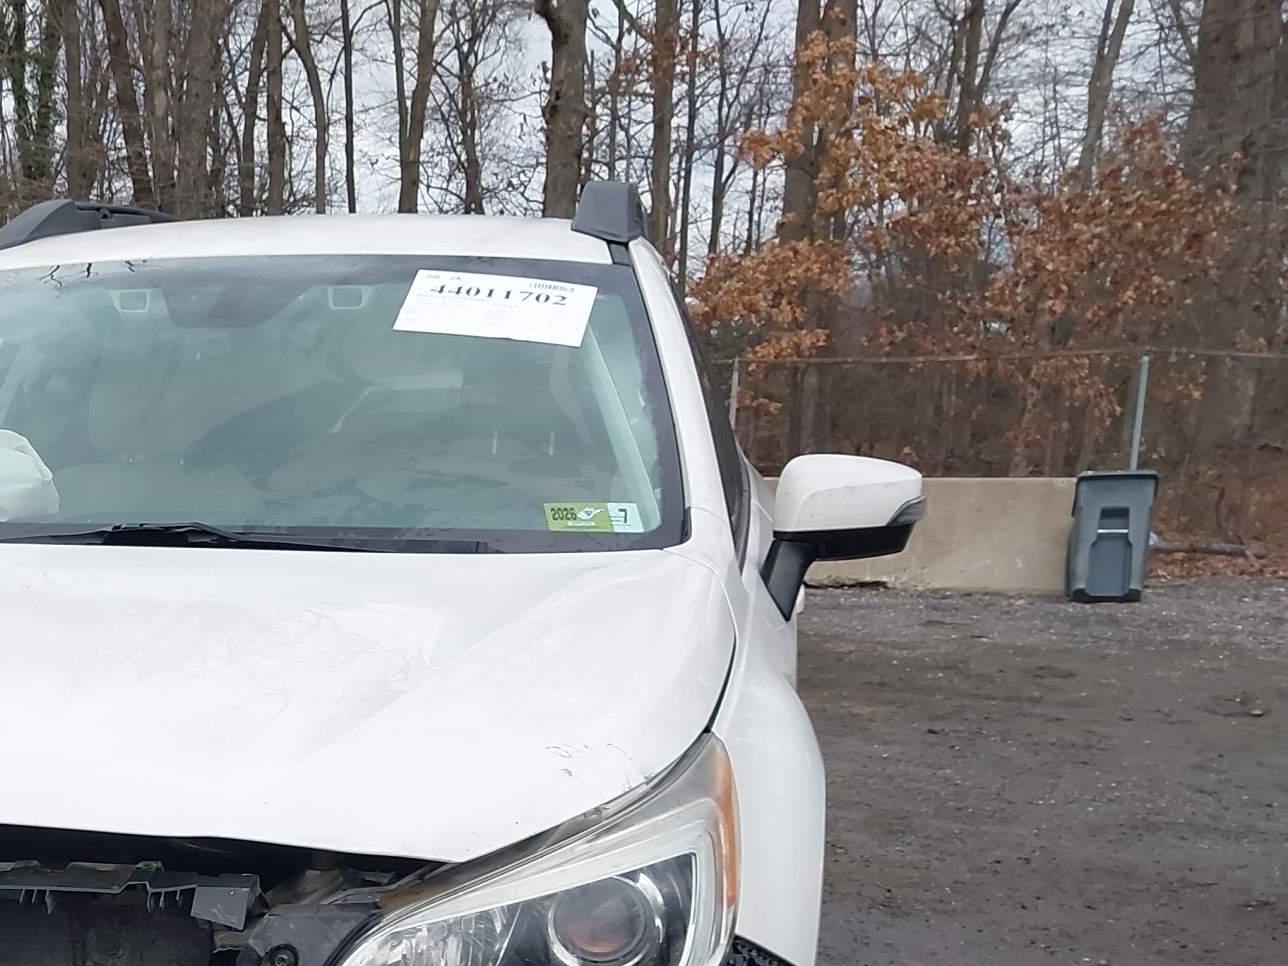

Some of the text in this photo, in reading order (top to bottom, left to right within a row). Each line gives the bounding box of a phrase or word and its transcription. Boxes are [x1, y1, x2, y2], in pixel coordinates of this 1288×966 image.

[429, 283, 568, 306] 44011702
[550, 507, 628, 524] 2026 7
